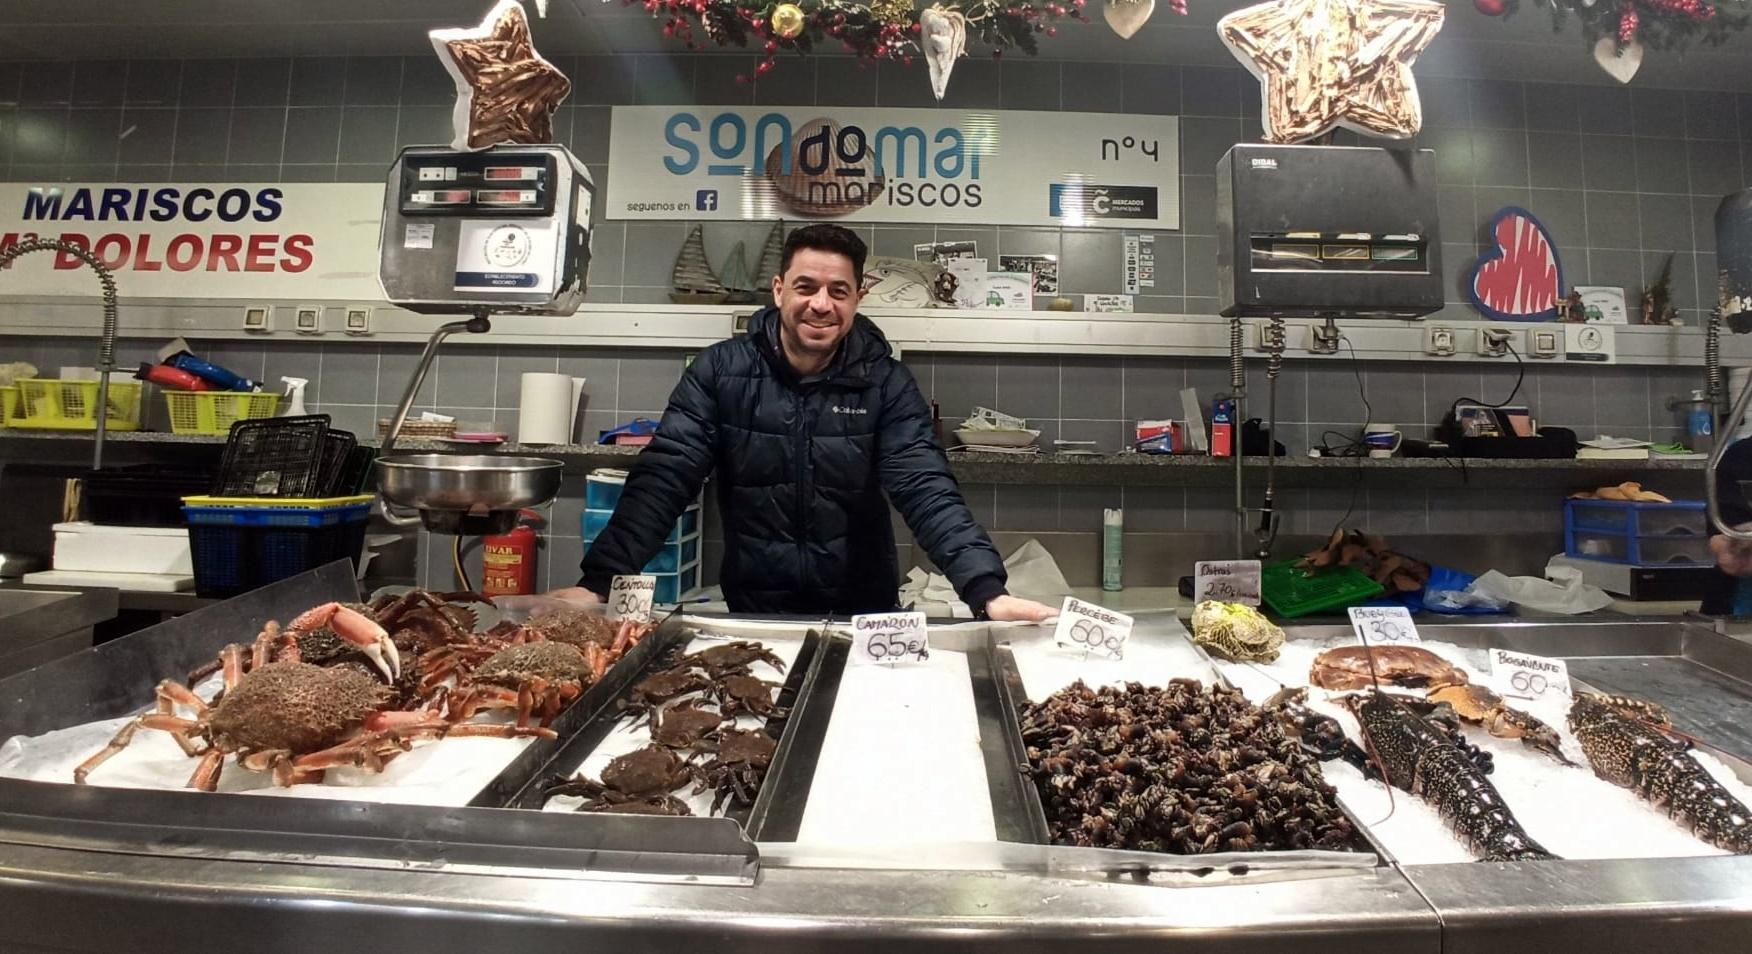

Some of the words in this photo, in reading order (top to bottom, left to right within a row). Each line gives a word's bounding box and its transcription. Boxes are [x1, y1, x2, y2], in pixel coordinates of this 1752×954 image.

[1141, 140, 1158, 163] 4
[22, 186, 284, 222] MARISCOS
[626, 202, 676, 212] seguenos
[677, 202, 691, 211] en
[807, 178, 983, 208] mariscos
[54, 233, 314, 273] DOLORES
